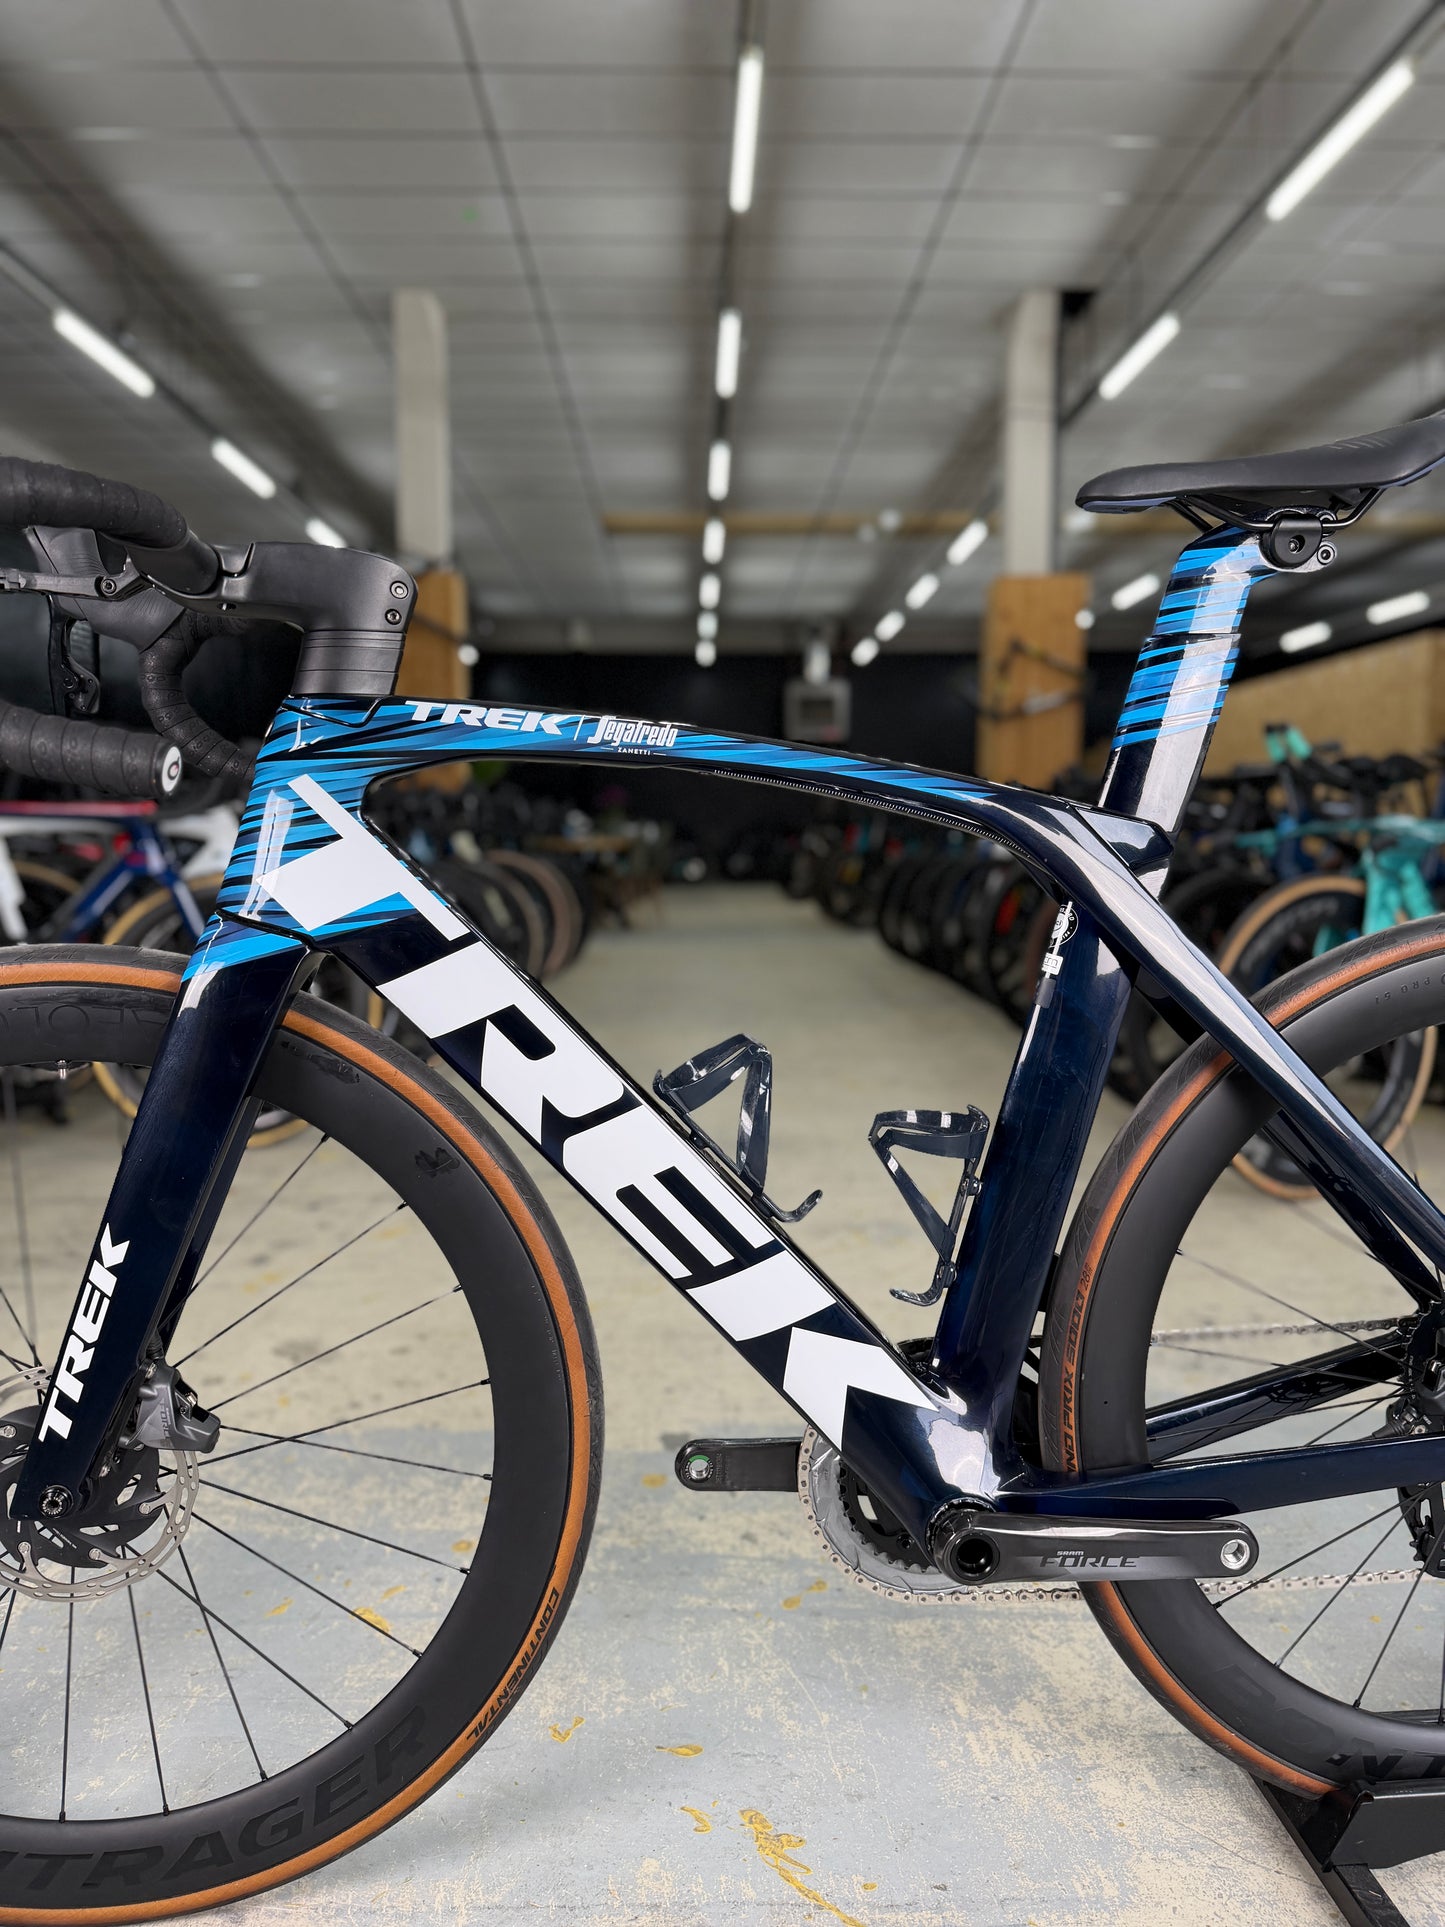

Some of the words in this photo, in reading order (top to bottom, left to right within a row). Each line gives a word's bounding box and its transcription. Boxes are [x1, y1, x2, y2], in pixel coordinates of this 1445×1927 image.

[405, 700, 578, 735] TREK
[617, 747, 651, 755] ZANETTI
[0, 1003, 170, 1042] AEOL
[256, 774, 937, 1450] TREK
[38, 1222, 130, 1443] TREK
[1066, 1289, 1085, 1366] 5000
[1063, 1366, 1074, 1430] PRIX
[1039, 1556, 1138, 1568] FORCE
[466, 1586, 560, 1740] CONTINENTAL
[0, 1704, 428, 1890] TRAGER
